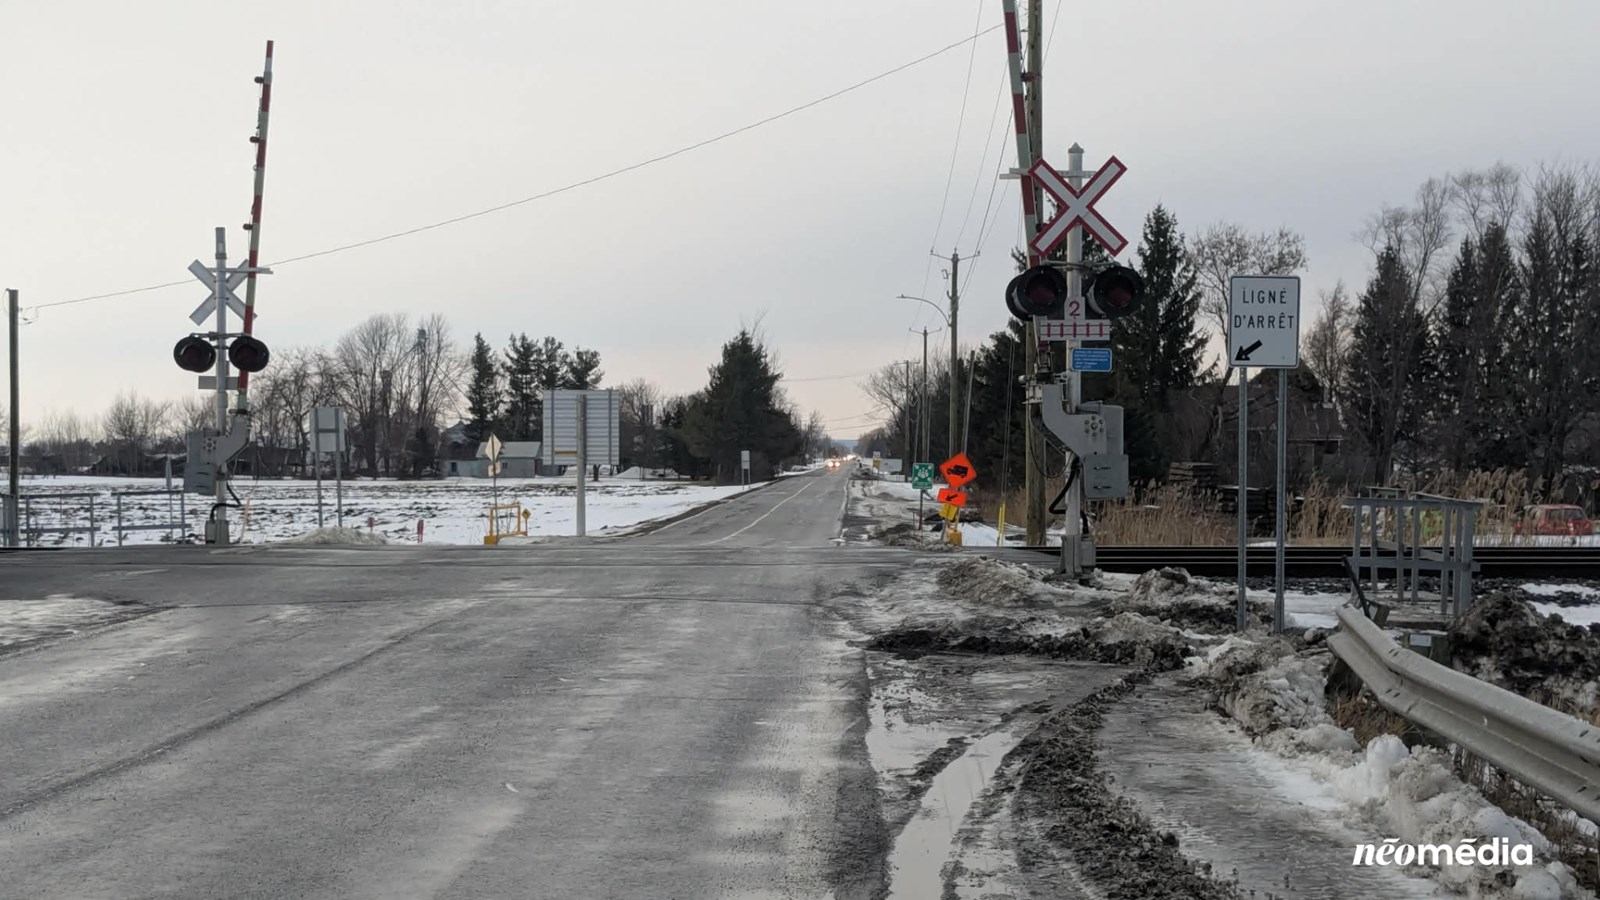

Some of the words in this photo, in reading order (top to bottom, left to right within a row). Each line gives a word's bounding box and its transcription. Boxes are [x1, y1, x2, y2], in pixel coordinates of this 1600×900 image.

[1242, 290, 1287, 304] LIGNE
[1069, 300, 1081, 317] 2
[1234, 312, 1295, 329] D'ARRÊT
